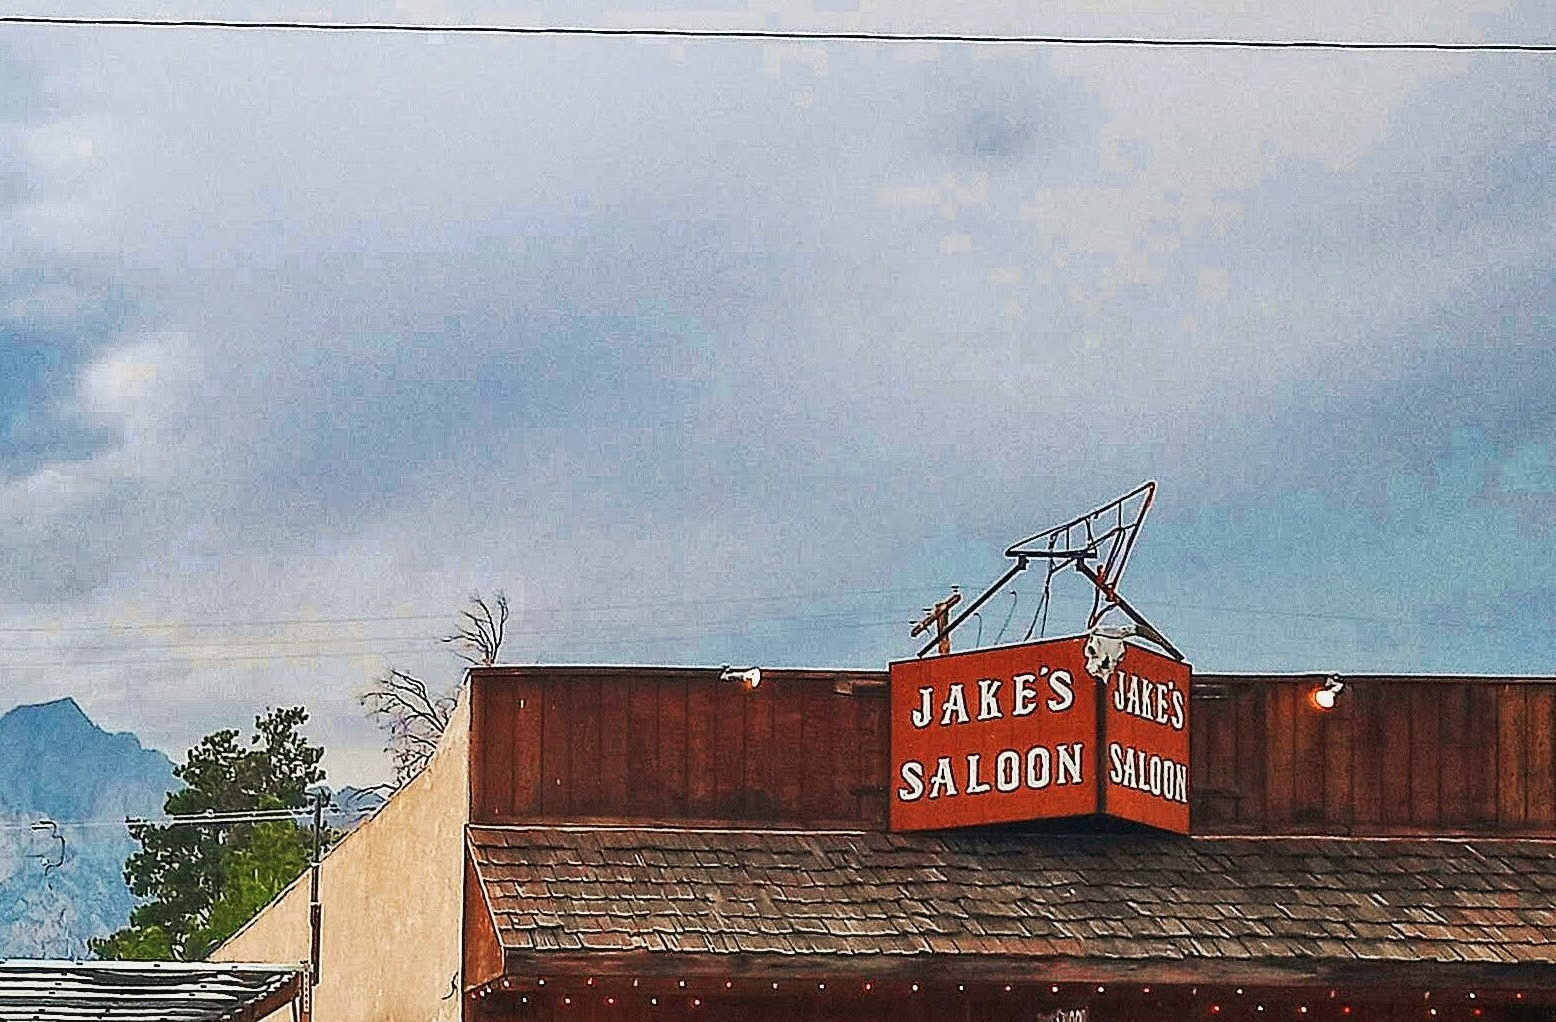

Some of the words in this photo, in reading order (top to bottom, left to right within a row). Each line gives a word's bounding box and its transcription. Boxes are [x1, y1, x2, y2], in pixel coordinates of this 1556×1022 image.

[912, 668, 1074, 728] JAKE'S
[1114, 671, 1185, 729] JAKE'S
[898, 743, 1083, 801] SALOON
[1109, 743, 1187, 803] SALOON
